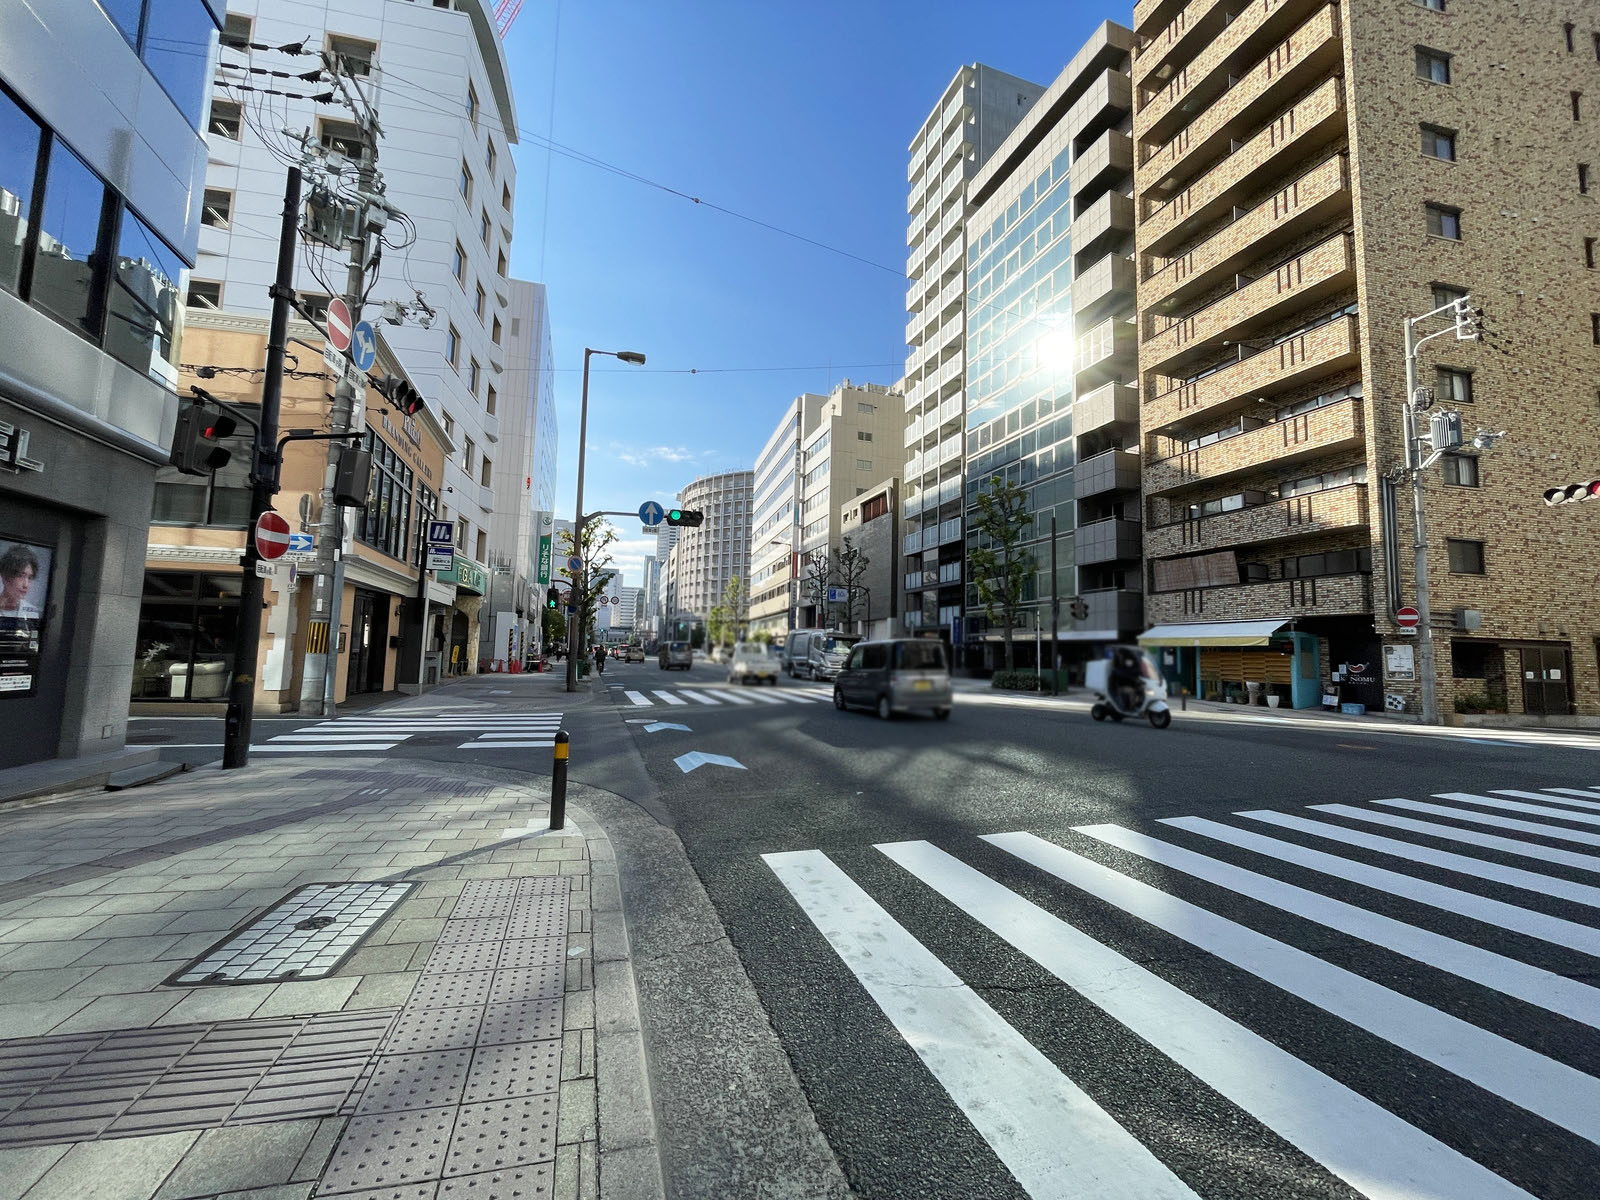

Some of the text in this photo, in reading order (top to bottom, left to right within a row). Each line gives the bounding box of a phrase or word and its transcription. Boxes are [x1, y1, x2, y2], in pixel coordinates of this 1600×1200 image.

[413, 452, 432, 480] GALLERY
[540, 543, 550, 578] りそな銀行
